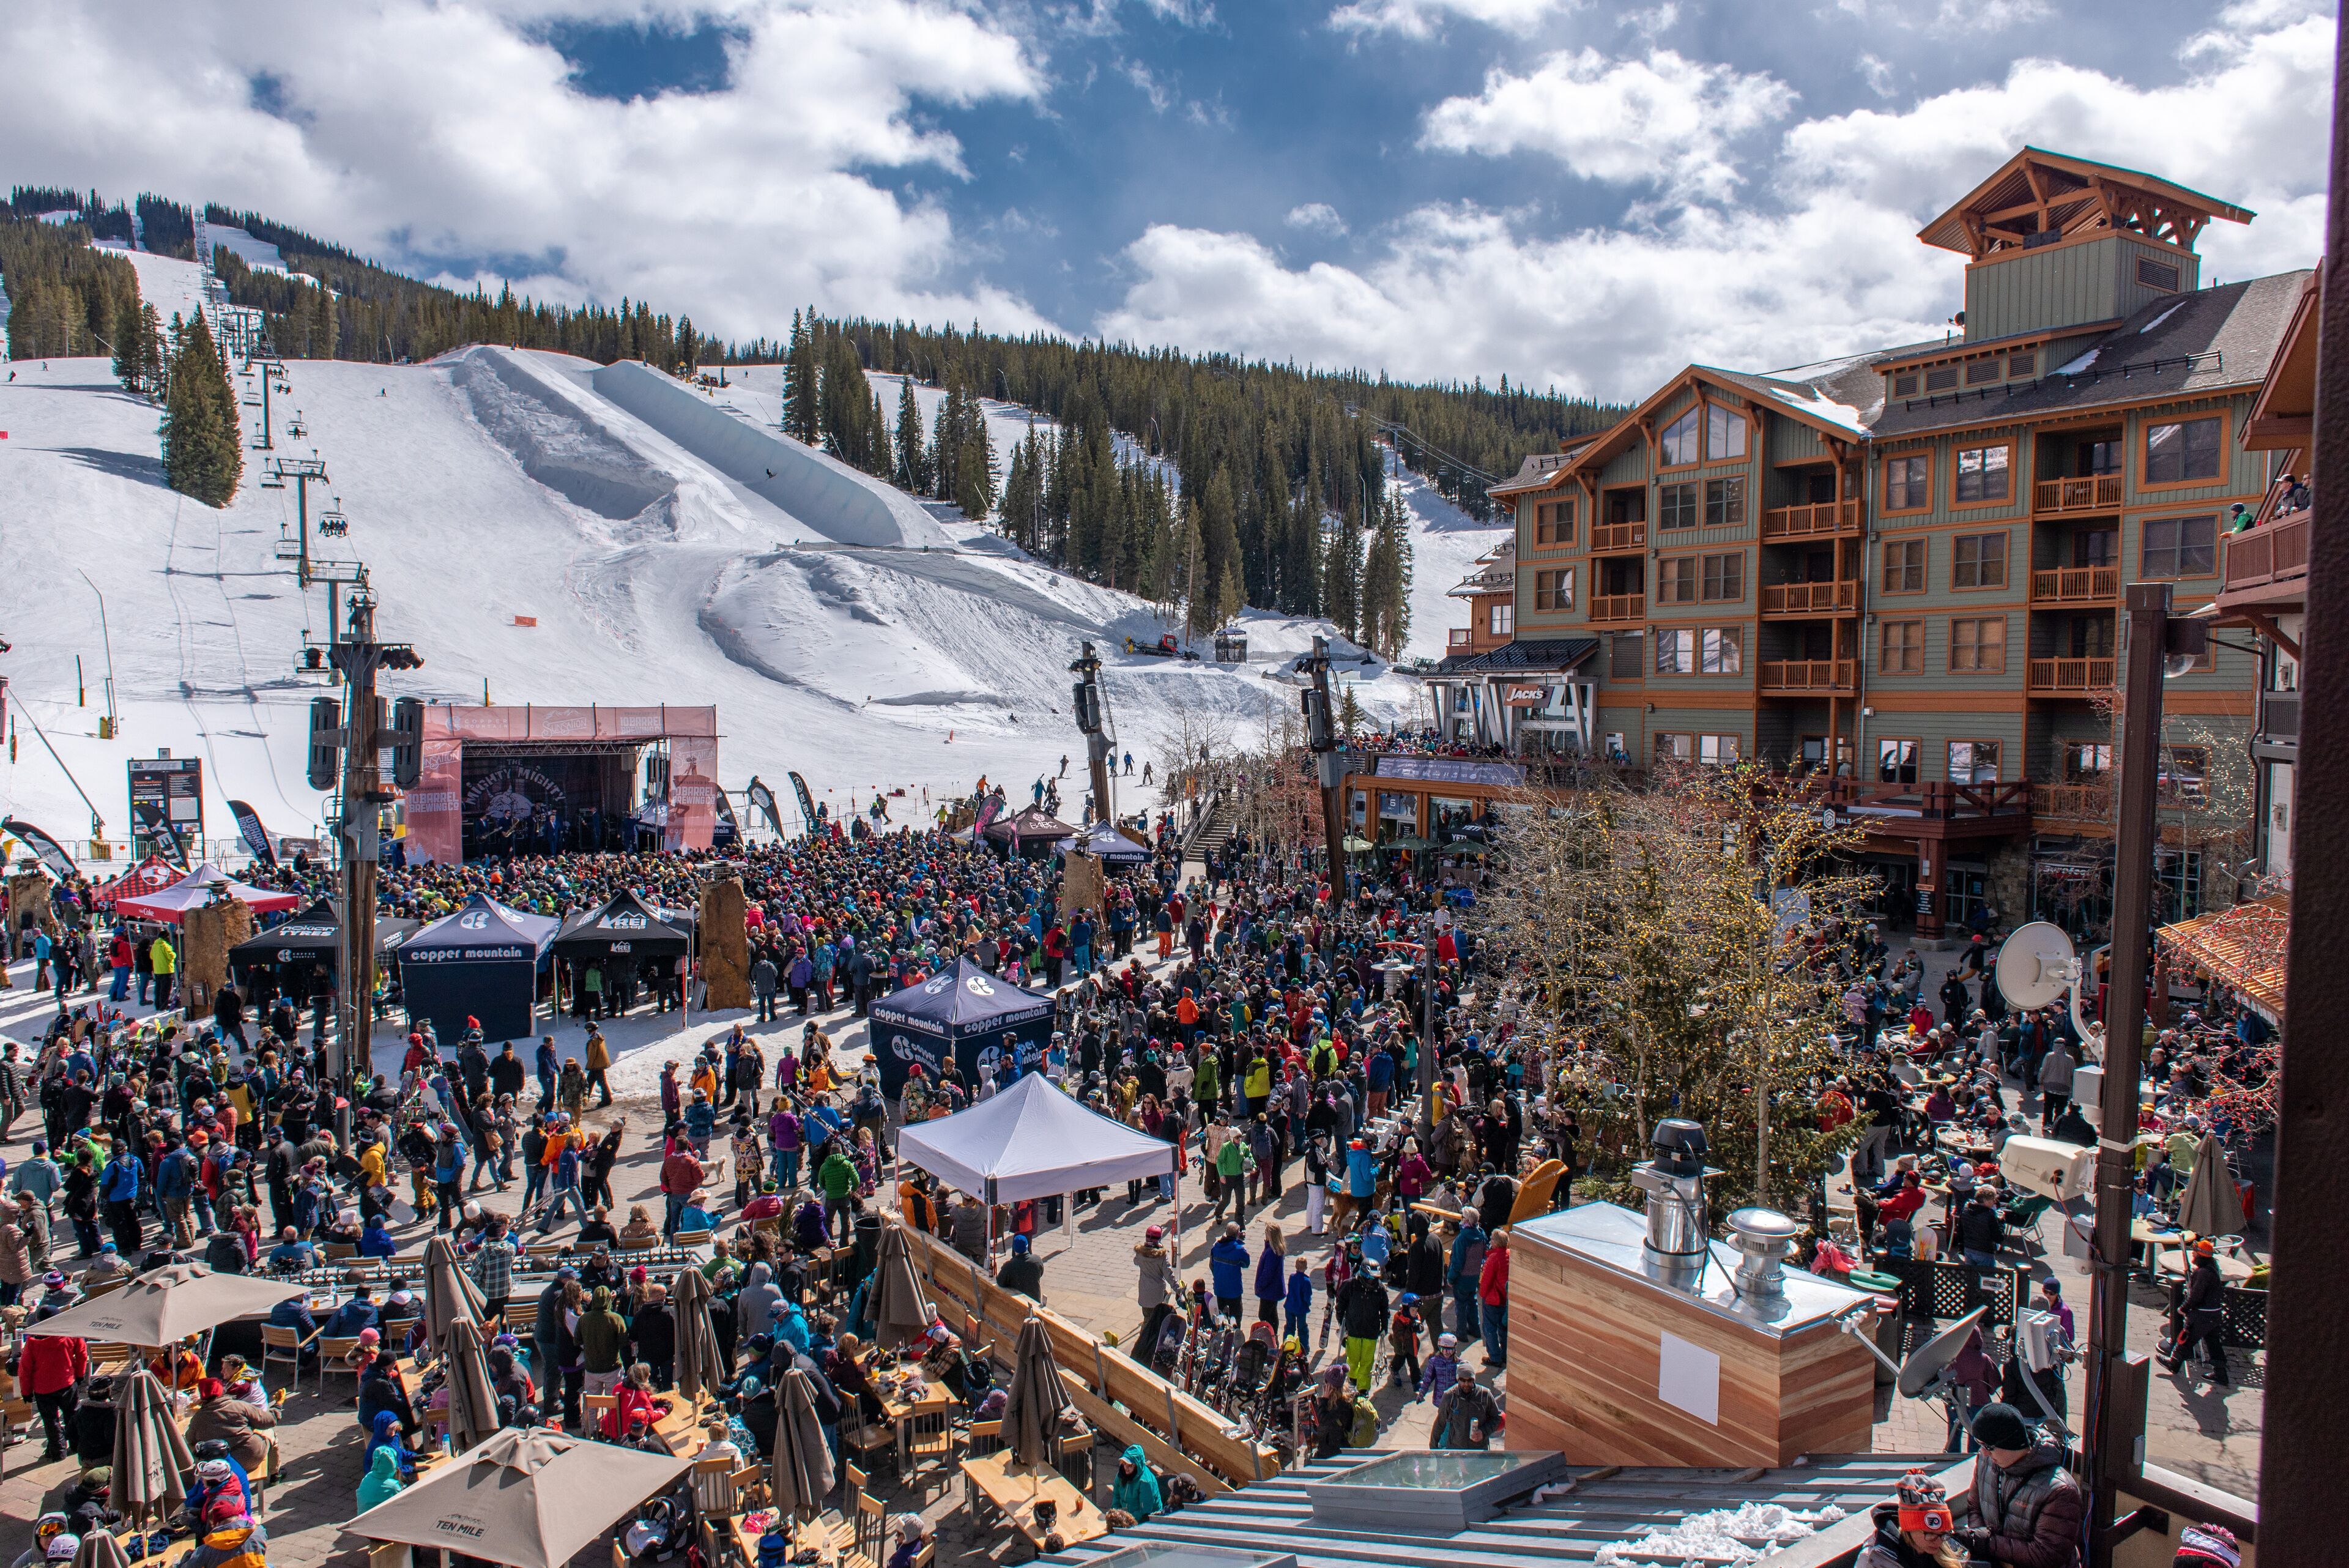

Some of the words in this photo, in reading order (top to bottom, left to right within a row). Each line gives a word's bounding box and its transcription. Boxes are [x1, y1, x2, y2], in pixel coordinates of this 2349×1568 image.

[1506, 688, 1544, 702] JACK'S
[409, 802, 447, 813] BREWING
[1390, 798, 1396, 807] 6
[150, 818, 184, 863] YETI
[143, 908, 154, 916] Coke
[410, 949, 461, 962] copper
[465, 946, 522, 958] mountain
[875, 1007, 905, 1023] copper
[908, 1017, 944, 1034] mountain
[964, 1016, 1002, 1033] copper
[1006, 1004, 1048, 1022] mountain
[911, 1043, 935, 1062] copper
[1019, 1040, 1036, 1055] per
[915, 1054, 941, 1075] mountain
[436, 1520, 458, 1531] TEN
[456, 1524, 484, 1537] MILE
